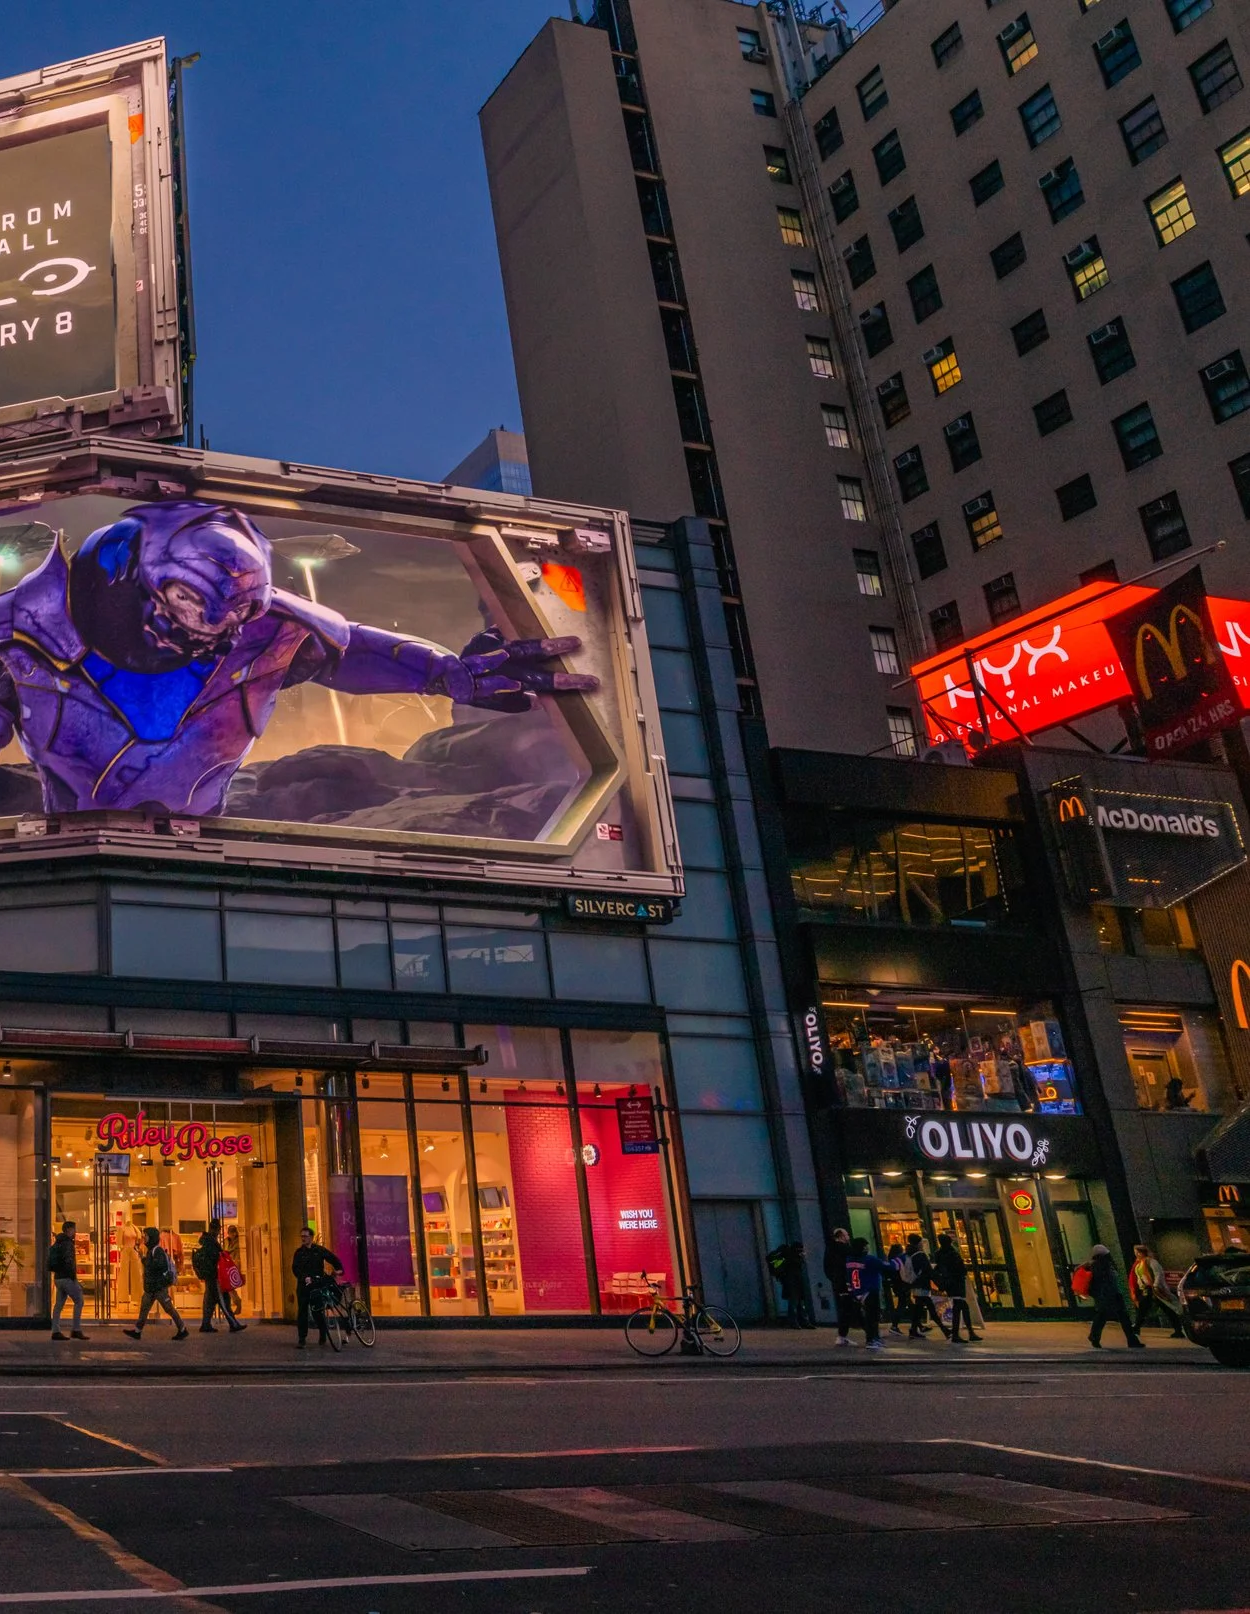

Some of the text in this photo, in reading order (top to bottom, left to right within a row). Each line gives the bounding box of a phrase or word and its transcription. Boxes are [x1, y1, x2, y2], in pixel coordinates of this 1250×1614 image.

[55, 311, 73, 336] 8
[943, 624, 1070, 709] NYX
[1052, 662, 1124, 698] MAKEU
[1155, 699, 1235, 750] OPEN 24 HRS
[1097, 805, 1220, 838] McDonald's
[805, 1013, 823, 1065] OLIYO
[97, 1110, 254, 1161] Riley Rose
[920, 1120, 1034, 1161] OLIYO
[618, 1219, 658, 1229] WERE HERE
[620, 1209, 653, 1219] WISH YOU
